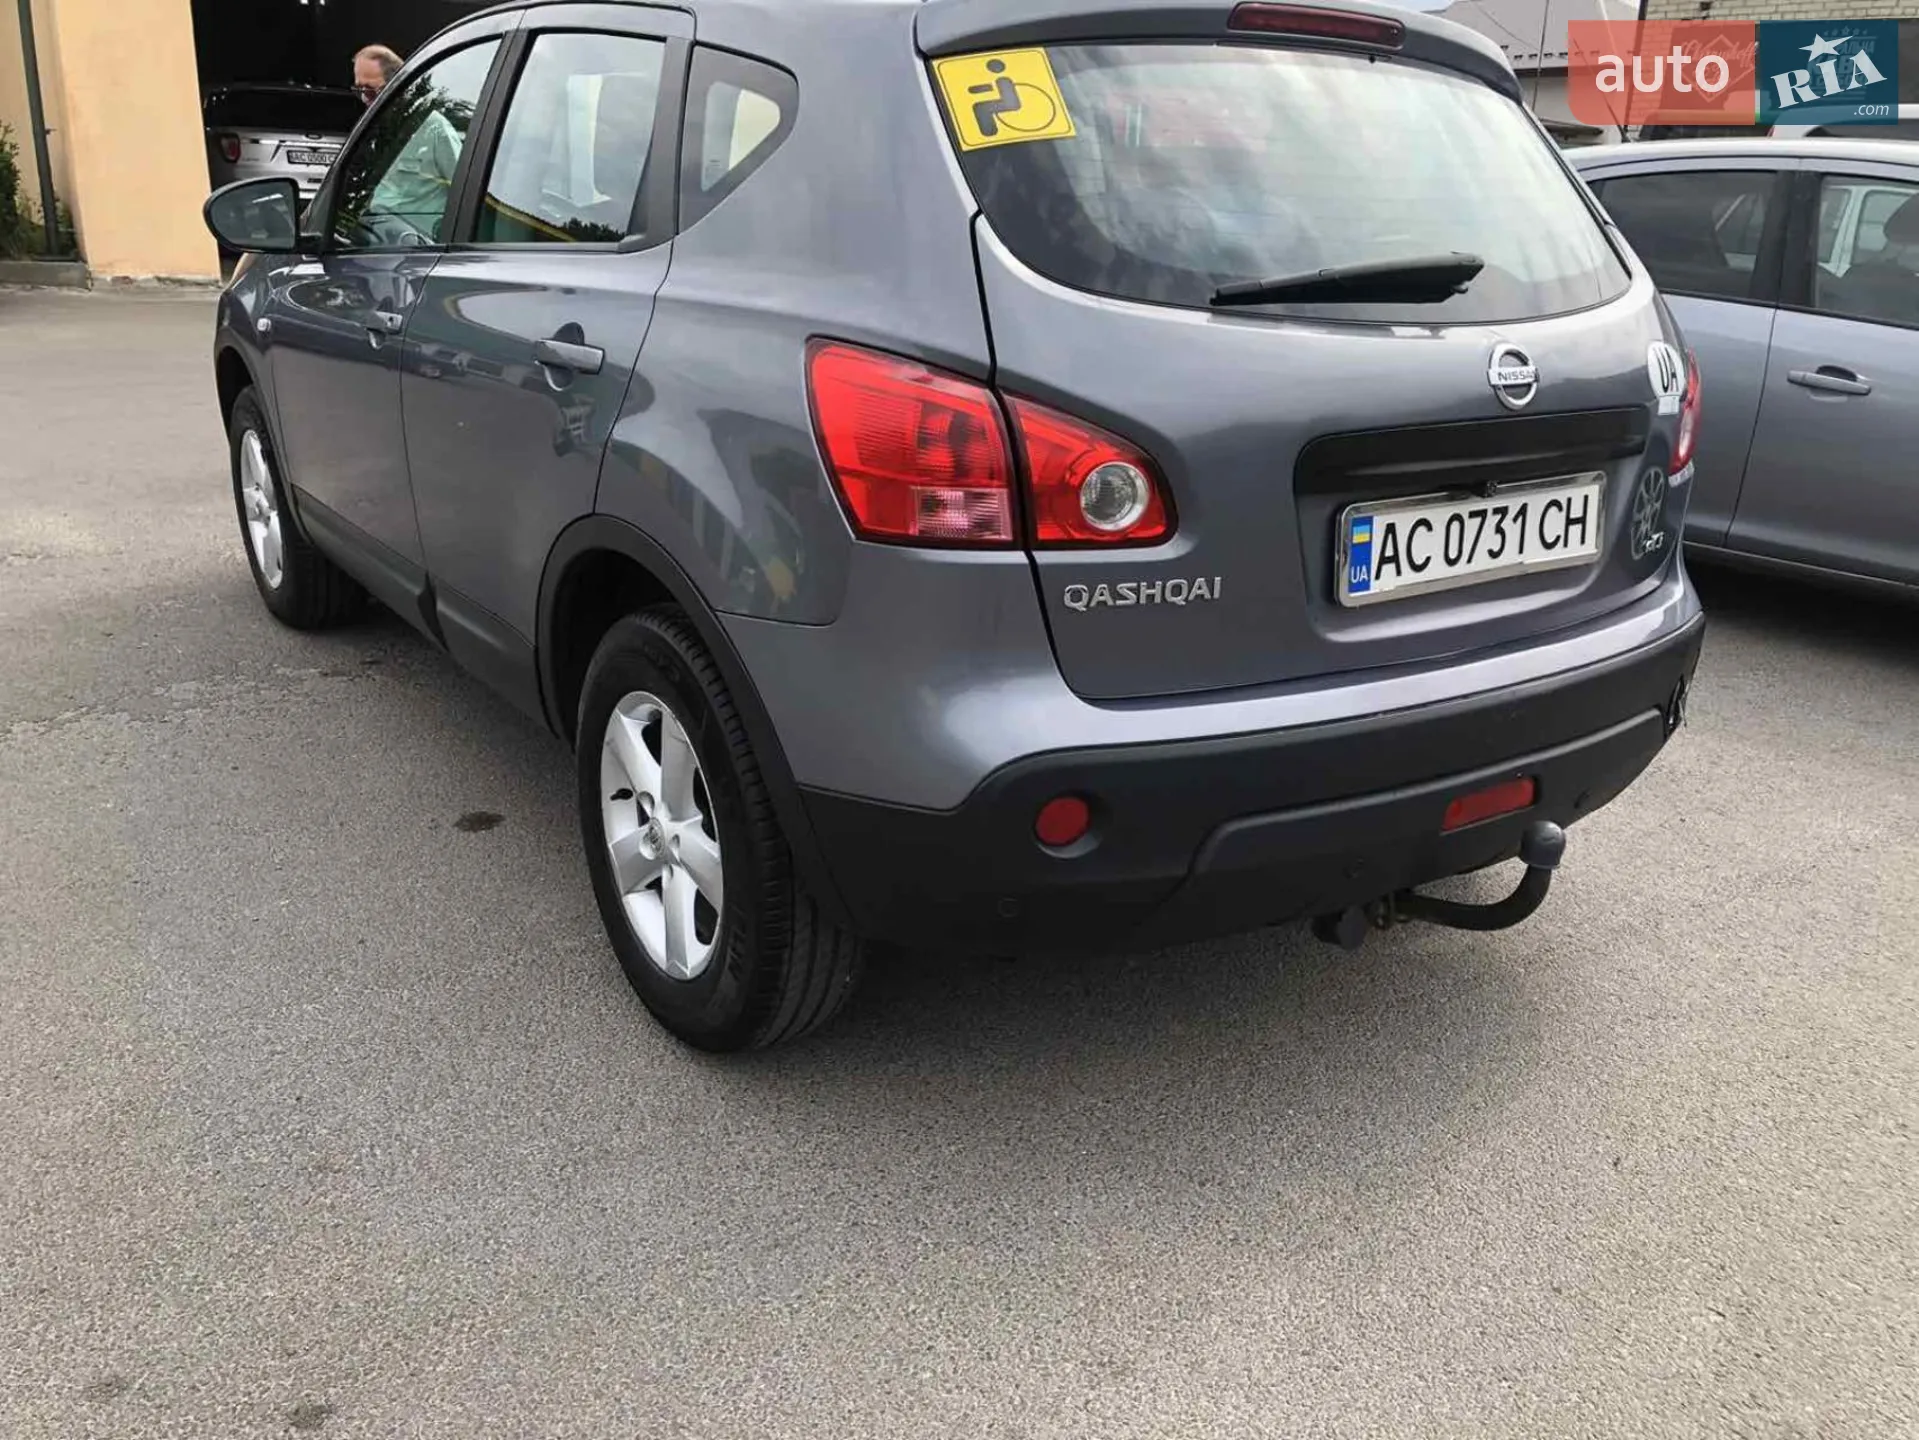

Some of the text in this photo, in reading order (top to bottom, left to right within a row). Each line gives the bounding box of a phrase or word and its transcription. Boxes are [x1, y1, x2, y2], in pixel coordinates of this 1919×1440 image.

[1652, 346, 1680, 394] UA
[1374, 494, 1590, 581] AC 0731 CH
[1062, 576, 1222, 612] QASHQAI
[1350, 565, 1369, 584] UA
